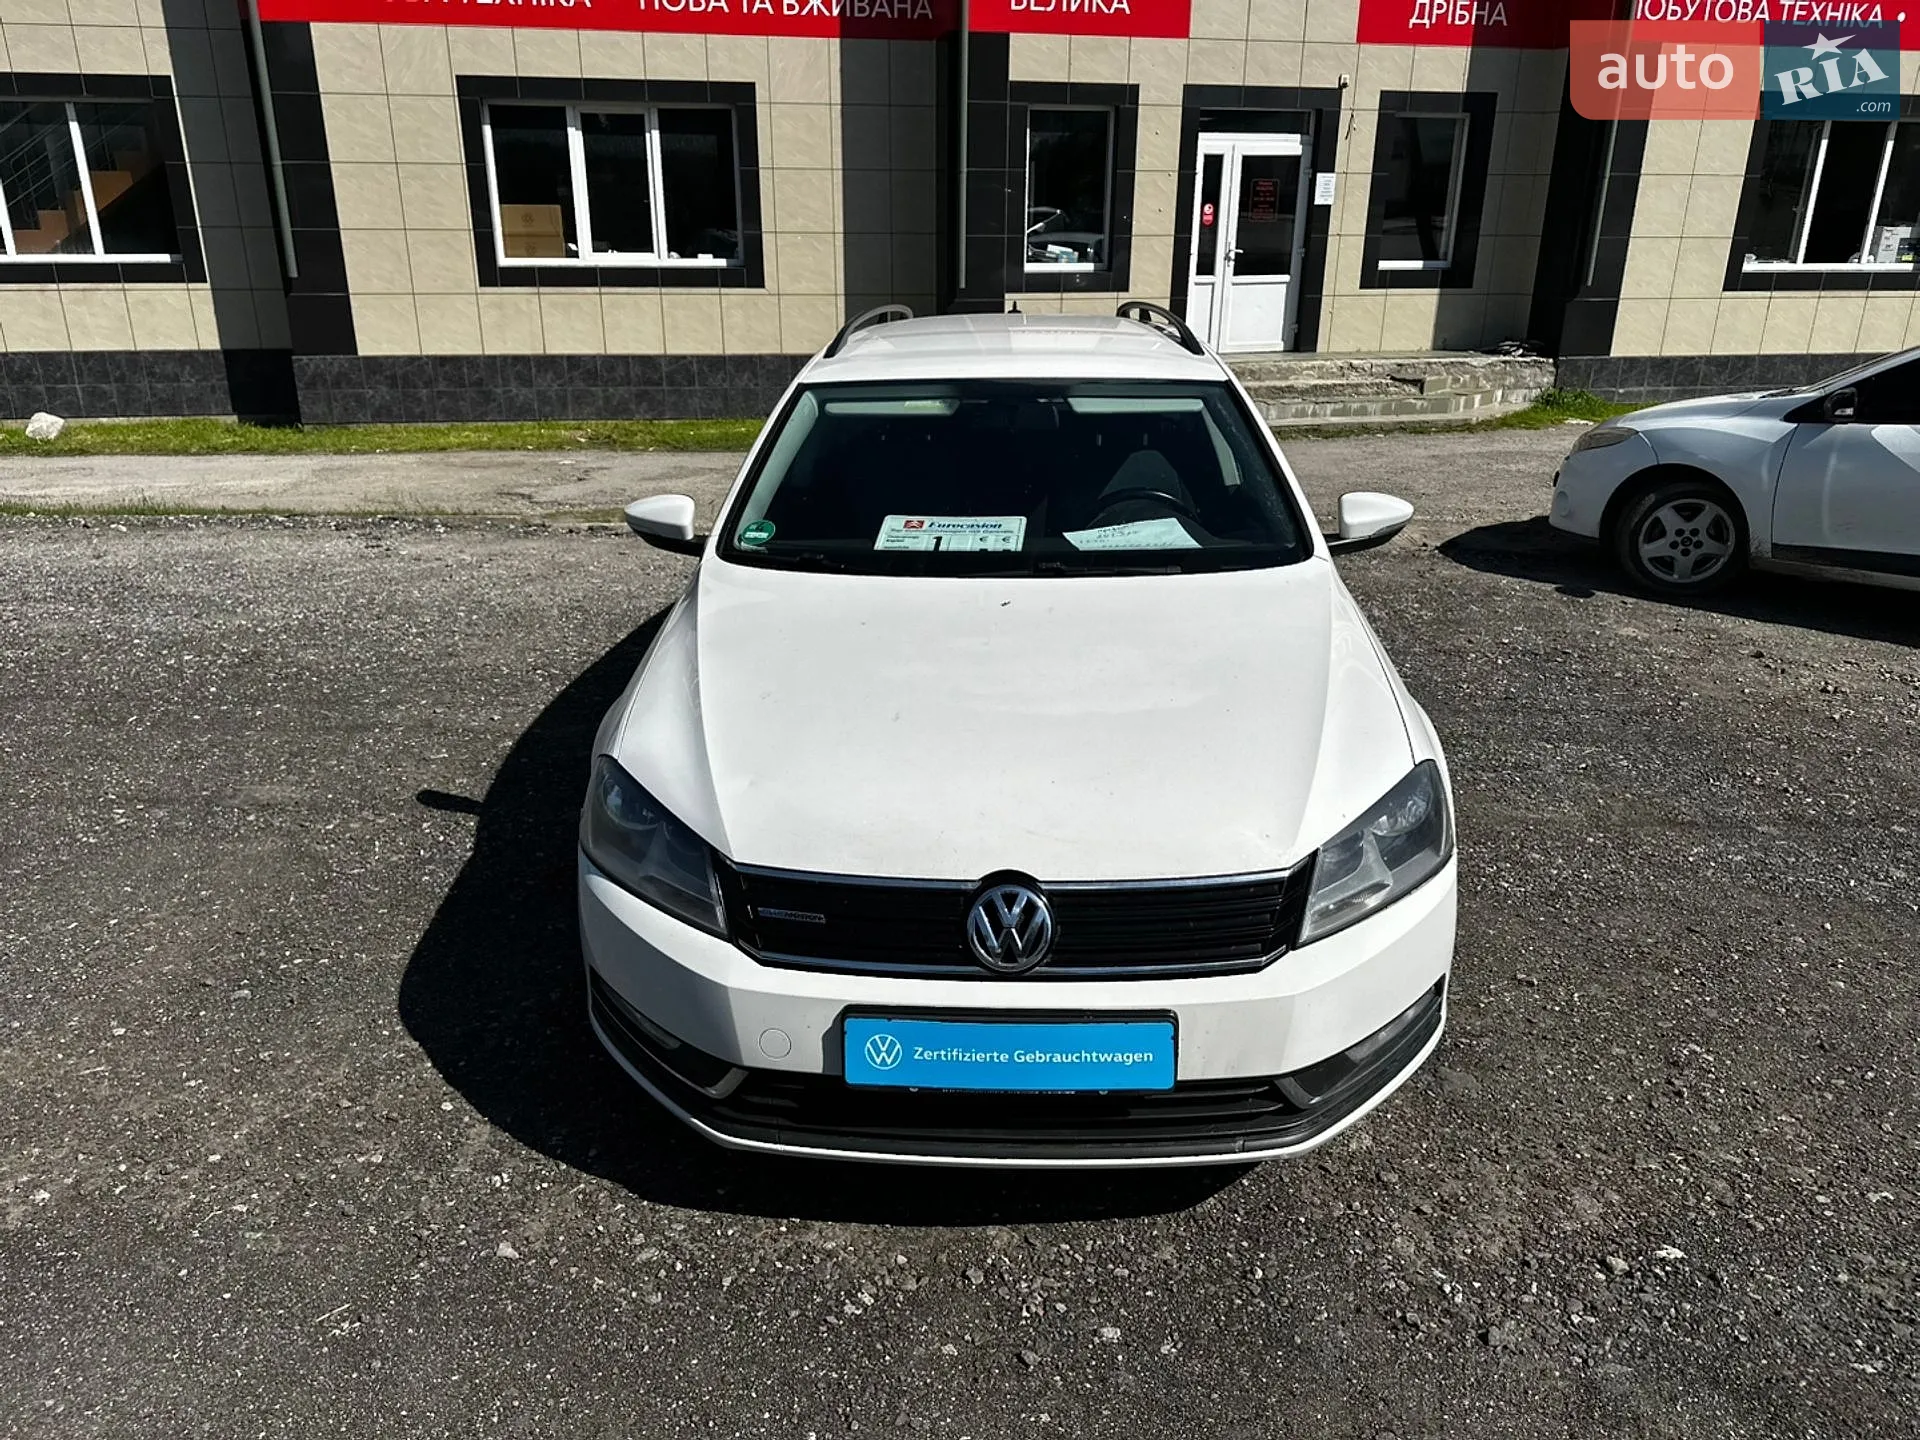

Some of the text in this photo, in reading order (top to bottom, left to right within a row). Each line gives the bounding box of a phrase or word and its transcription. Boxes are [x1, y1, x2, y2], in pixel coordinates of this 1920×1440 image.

[782, 0, 934, 19] ВЖИВАНА
[1408, 0, 1508, 29] ДРІБНА
[1780, 0, 1884, 28] ТЕХНІКА
[912, 1046, 1009, 1063] Zertifizierte
[1013, 1049, 1154, 1068] Gebrauchtwagen
